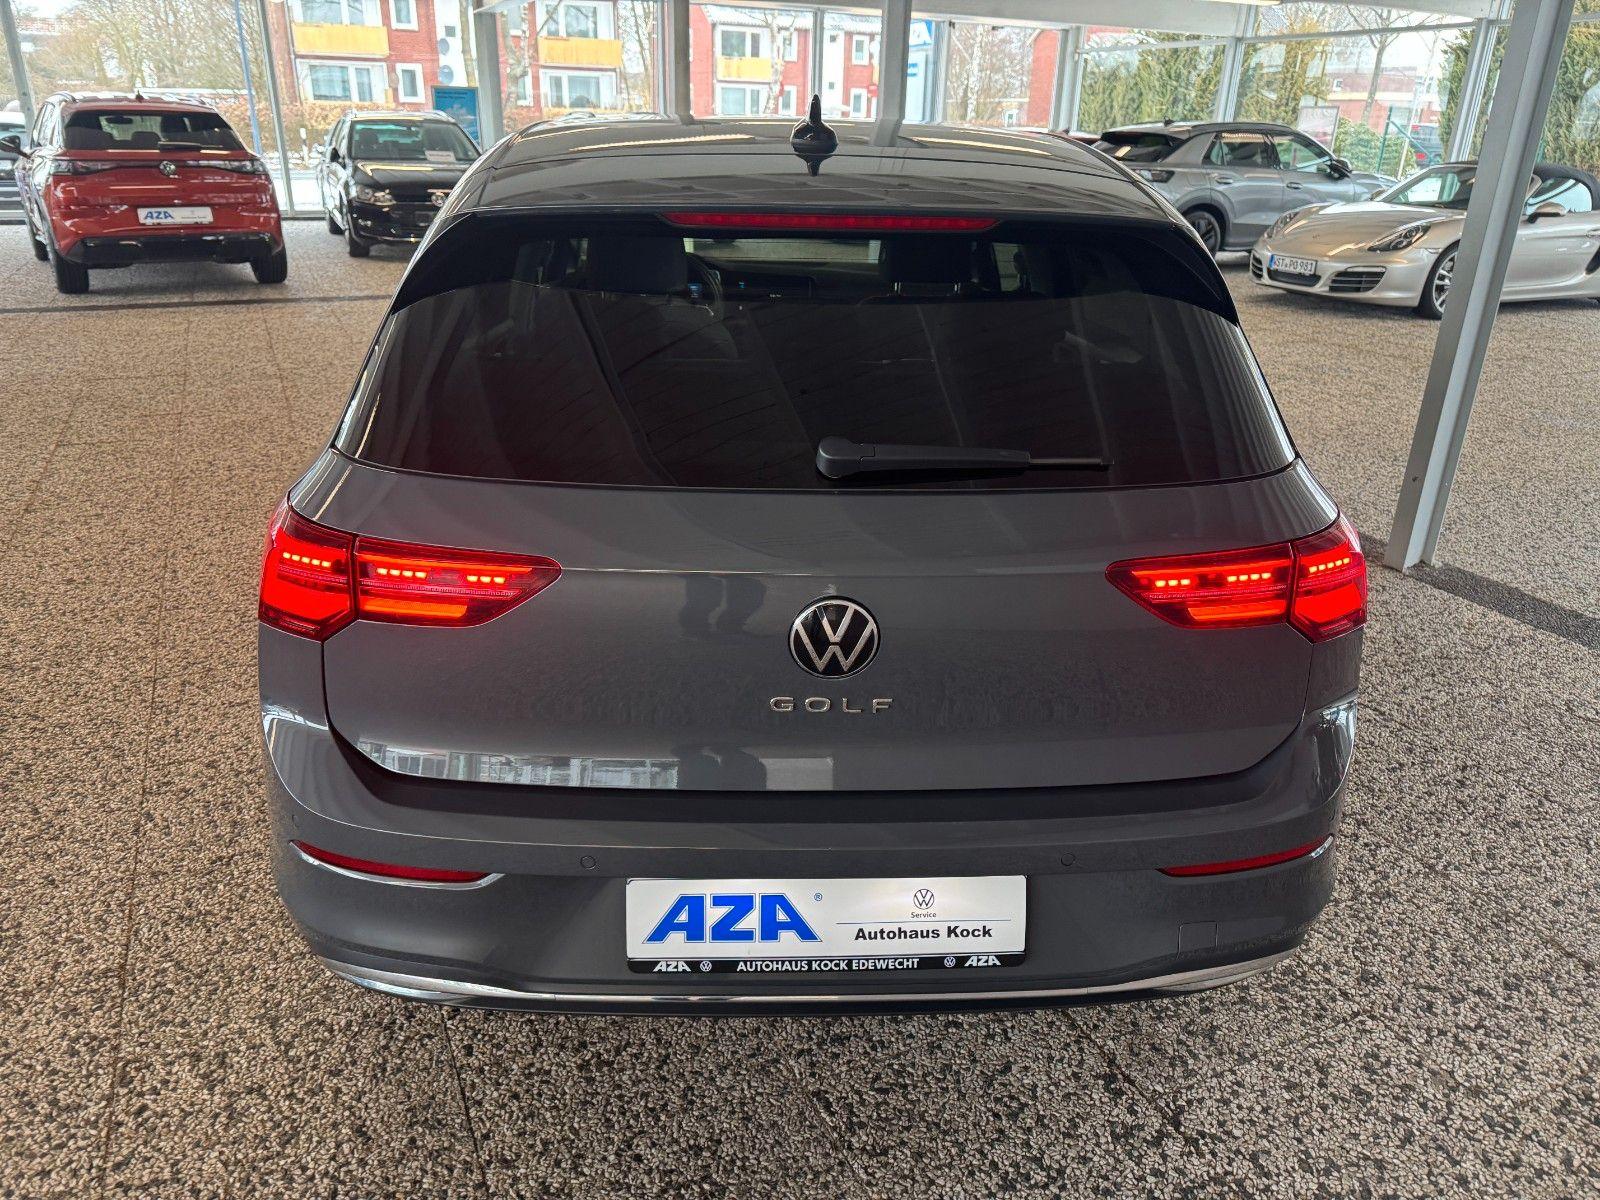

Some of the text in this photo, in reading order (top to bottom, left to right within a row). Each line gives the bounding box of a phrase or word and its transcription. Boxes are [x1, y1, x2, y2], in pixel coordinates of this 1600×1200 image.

[145, 211, 174, 220] AZA
[769, 696, 893, 714] GOLF
[642, 893, 823, 944] AZA
[910, 911, 937, 919] Service
[854, 925, 993, 941] Autohaus Kock
[653, 960, 692, 972] AZA
[736, 961, 809, 972] AUTOHAUS
[811, 959, 848, 971] KOCK
[852, 958, 919, 971] EDEWECHT
[964, 955, 1002, 967] AZA
